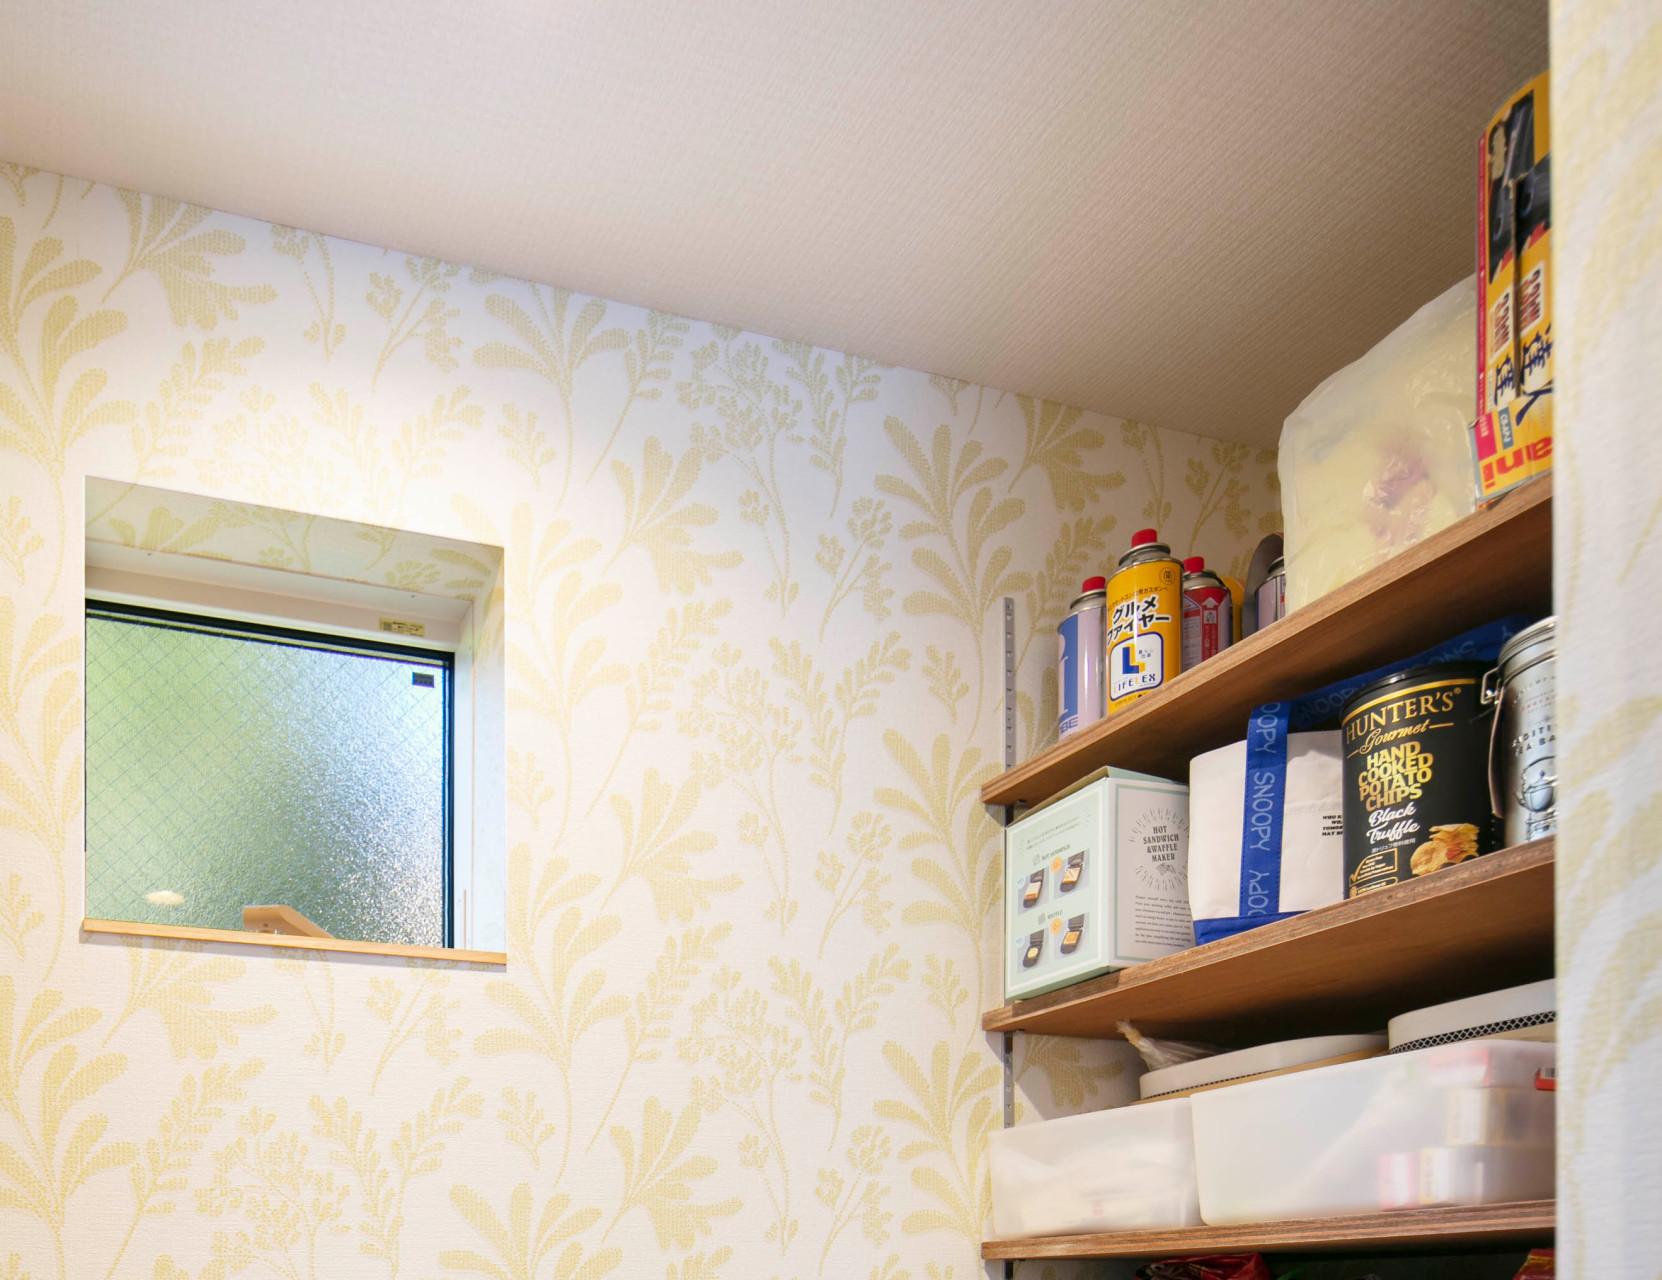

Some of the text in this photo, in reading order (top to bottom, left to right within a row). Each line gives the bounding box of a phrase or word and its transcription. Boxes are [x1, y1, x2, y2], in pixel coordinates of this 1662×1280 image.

[1113, 596, 1157, 624] グルメ
[1107, 612, 1170, 645] ファイヤー
[1113, 673, 1156, 694] LIFELEX
[1346, 691, 1454, 745] HUNTER'S
[1360, 719, 1430, 755] Gourmet
[1358, 753, 1434, 787] COOKED
[1367, 741, 1421, 770] HAND
[1359, 768, 1432, 801] POTATO
[1366, 783, 1423, 812] CHIPS
[1250, 771, 1275, 851] SNOOPY
[1368, 802, 1417, 827] Black
[1143, 833, 1179, 845] SANDWICH
[1153, 825, 1167, 834] HOT
[1366, 819, 1421, 845] Truffle
[1152, 852, 1175, 862] MAKER
